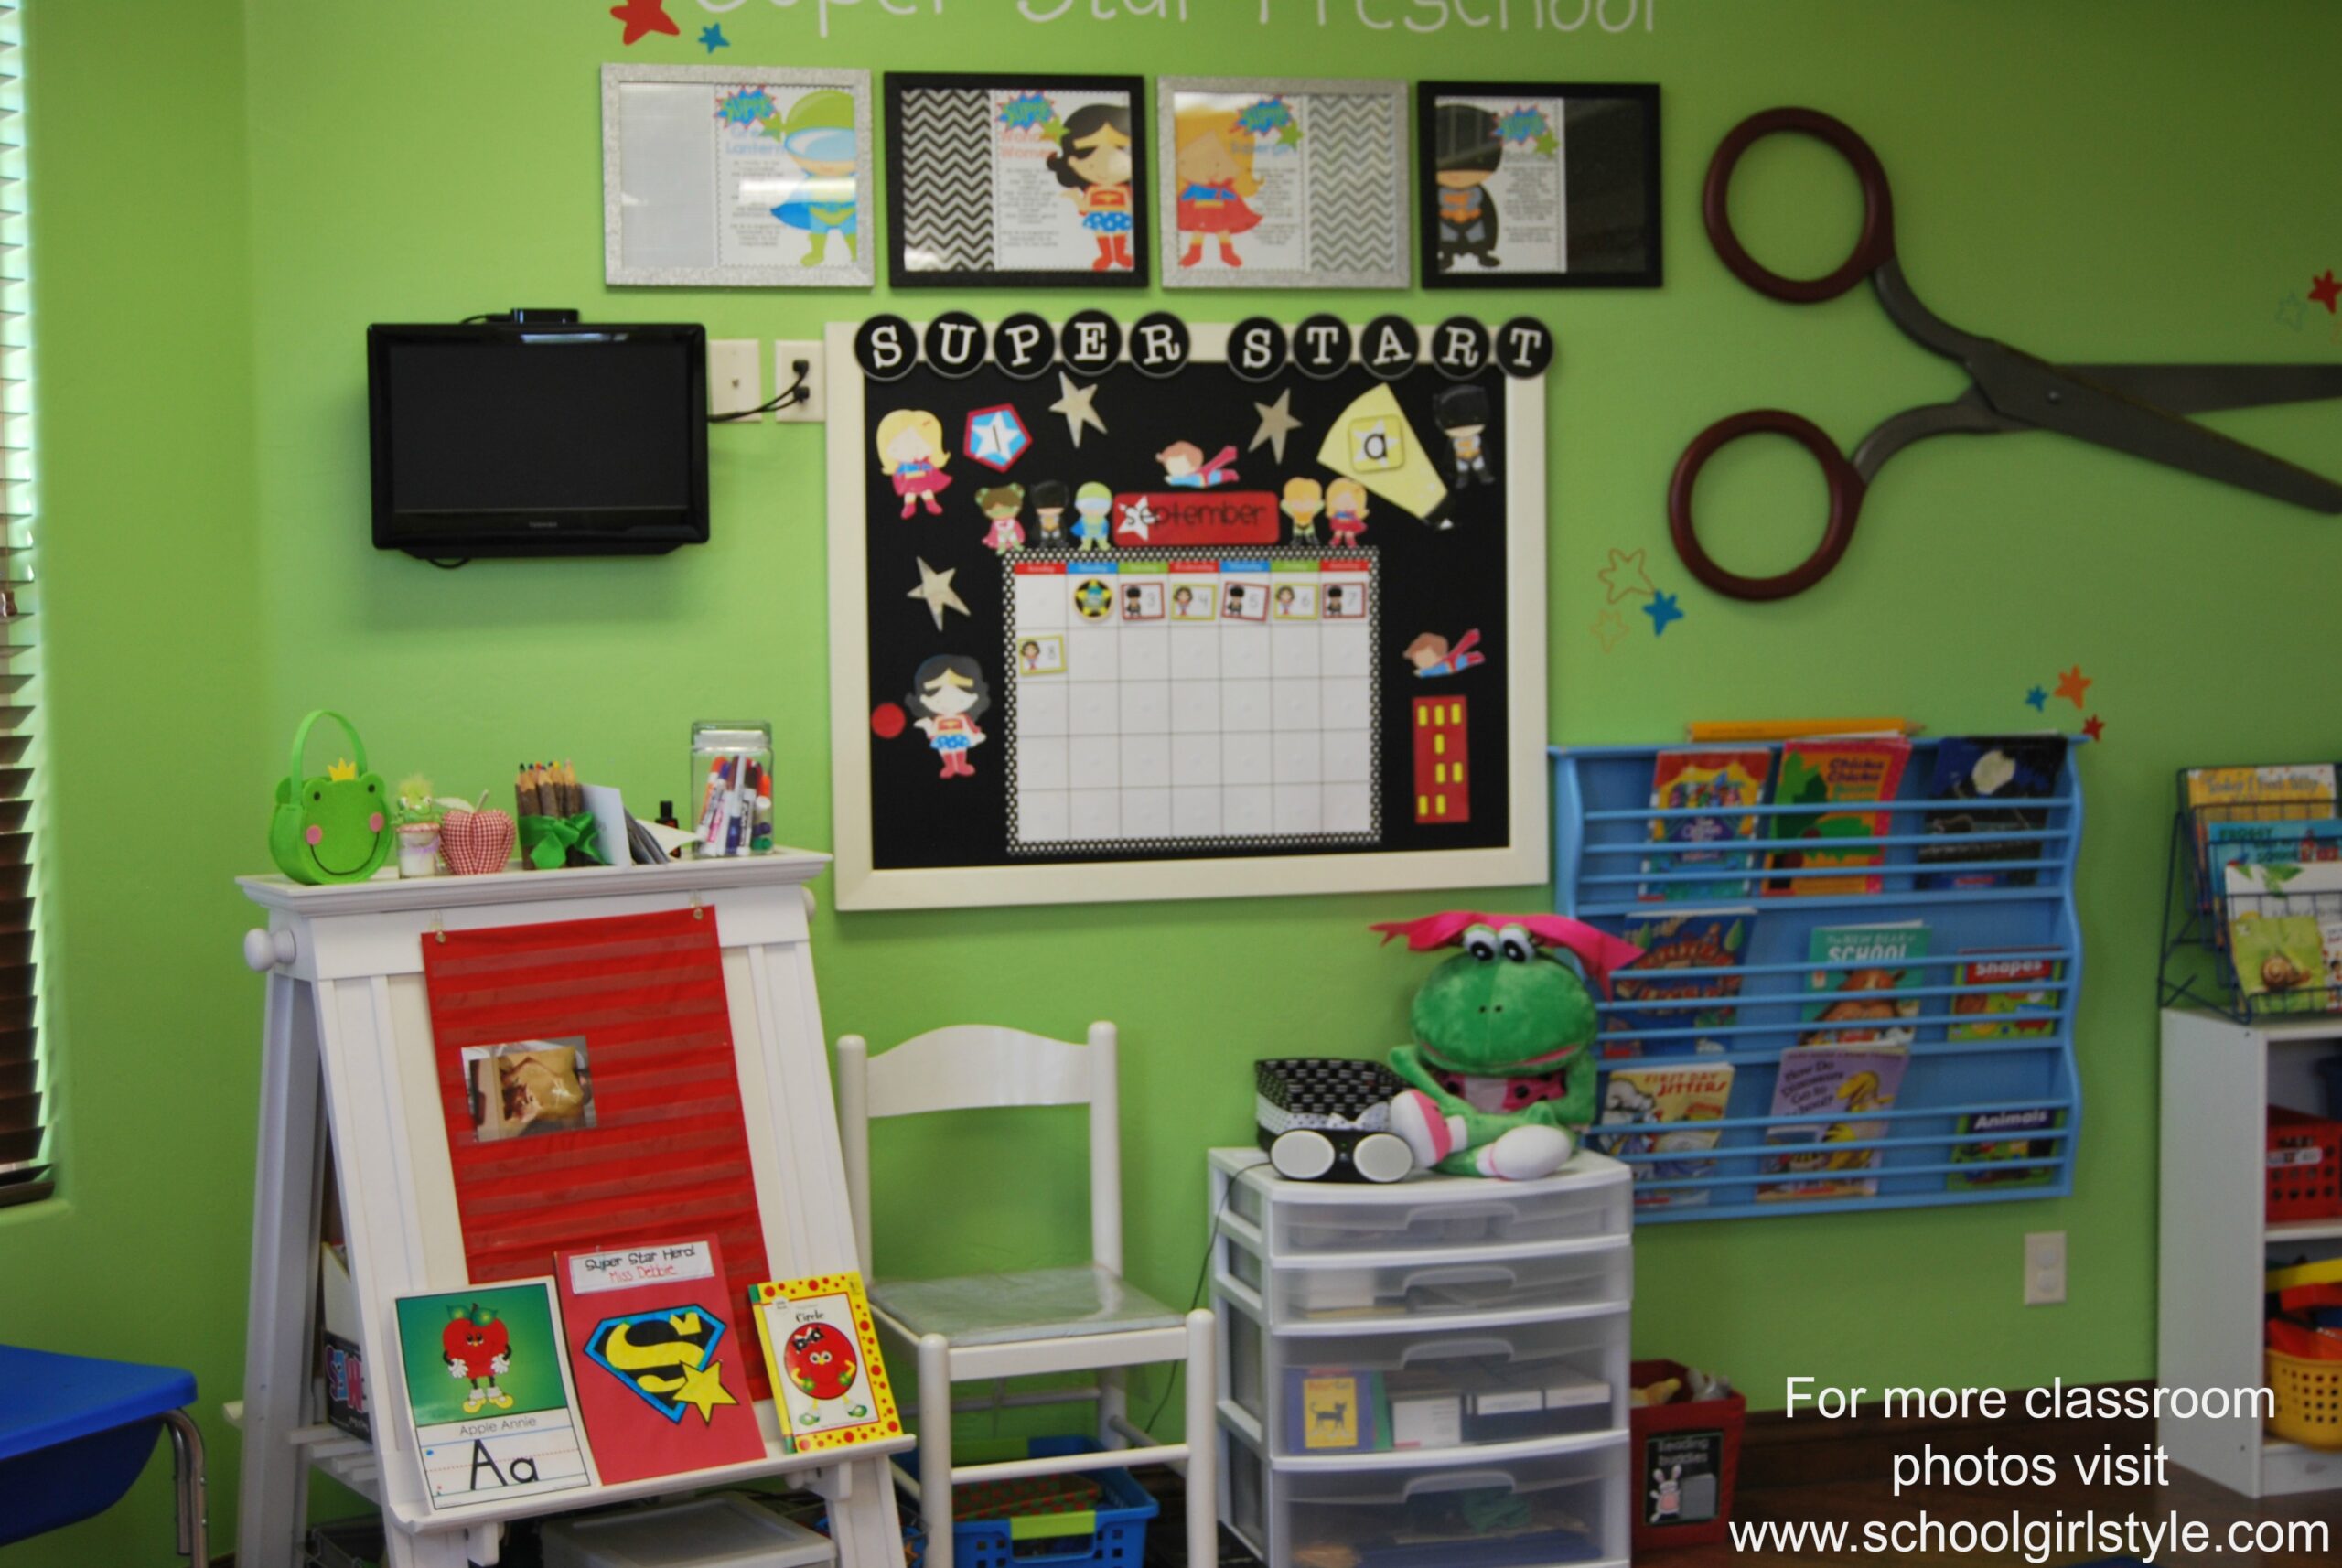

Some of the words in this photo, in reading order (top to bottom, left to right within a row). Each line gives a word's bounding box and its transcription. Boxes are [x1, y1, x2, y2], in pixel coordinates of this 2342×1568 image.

[871, 321, 1180, 368] SUPER
[1242, 325, 1542, 368] START
[1364, 432, 1388, 460] a
[1125, 499, 1267, 530] september
[1974, 1110, 2047, 1130] Animals
[585, 1257, 623, 1273] Super
[628, 1251, 657, 1265] Star
[609, 1270, 633, 1283] Miss
[459, 1422, 498, 1436] Apple
[500, 1415, 537, 1429] Annie
[469, 1438, 540, 1491] Aa
